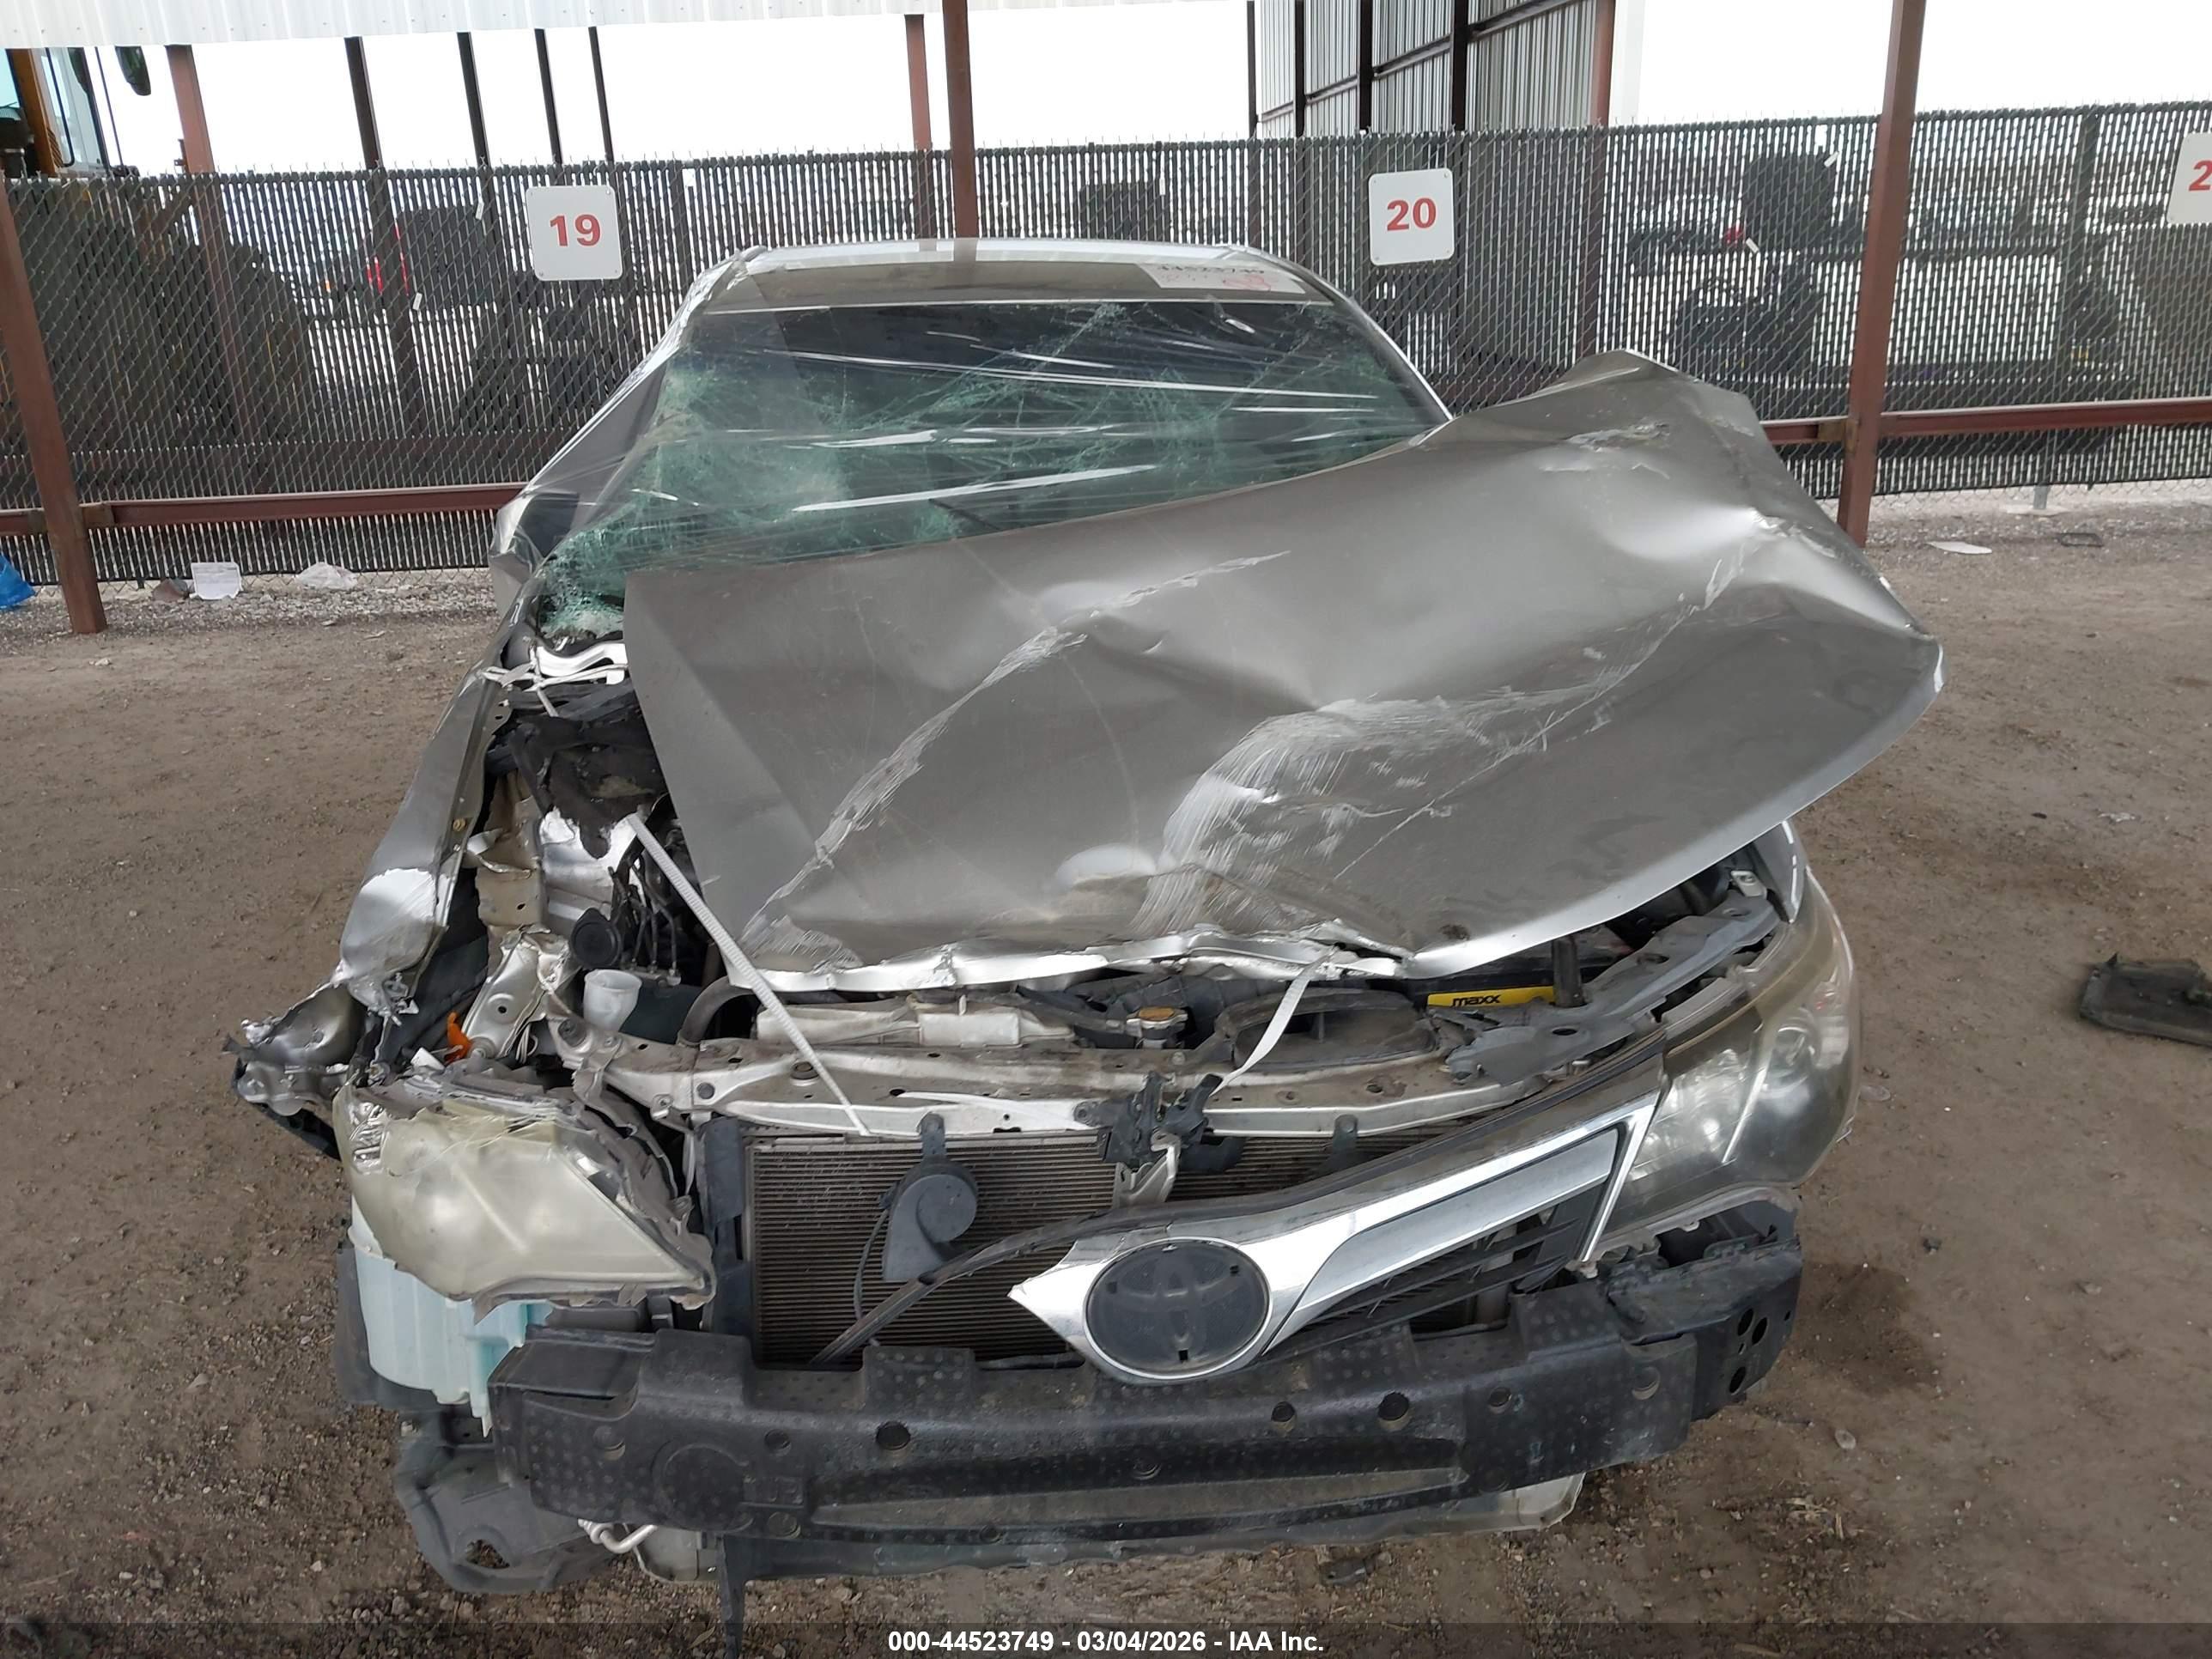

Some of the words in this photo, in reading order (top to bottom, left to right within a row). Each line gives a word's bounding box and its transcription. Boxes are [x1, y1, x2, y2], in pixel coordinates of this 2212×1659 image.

[550, 214, 601, 246] 19
[1387, 198, 1437, 232] 20
[1451, 994, 1501, 1007] maxx
